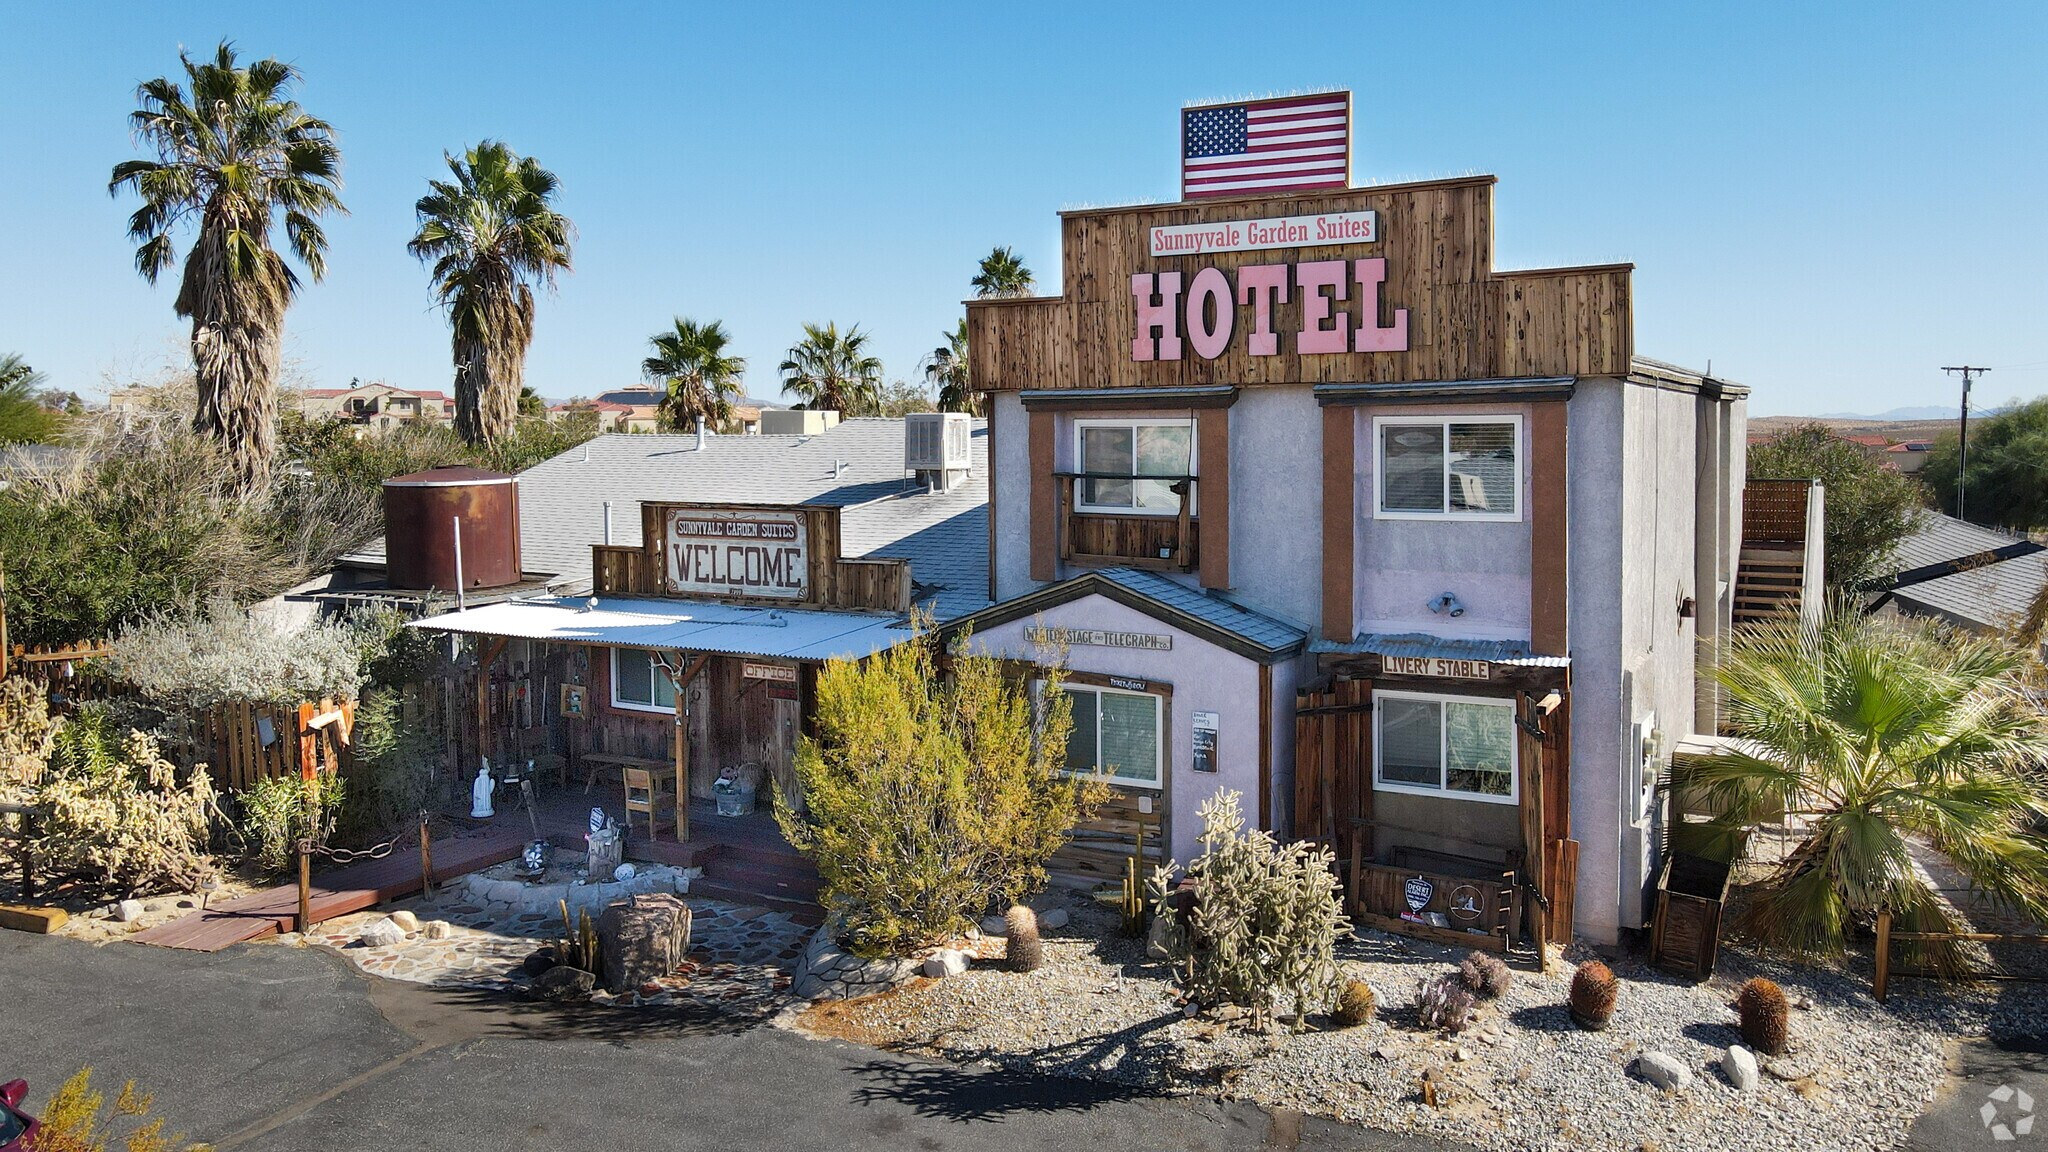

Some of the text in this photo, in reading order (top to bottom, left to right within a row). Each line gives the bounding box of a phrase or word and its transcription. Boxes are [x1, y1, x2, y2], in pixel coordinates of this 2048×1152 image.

[1154, 215, 1371, 253] Sunnyvale Garden Suites
[1131, 257, 1408, 361] HOTEL
[678, 520, 795, 538] SUNNYVALE GARDEN SUITES
[673, 543, 801, 588] WELCOME
[1067, 630, 1094, 643] STAGE
[1104, 632, 1157, 648] TELEGRAPH
[1159, 641, 1169, 649] CO.
[746, 665, 793, 679] OFFICE
[1384, 655, 1488, 678] LIVERY STABLE
[1408, 883, 1429, 894] DESERT
